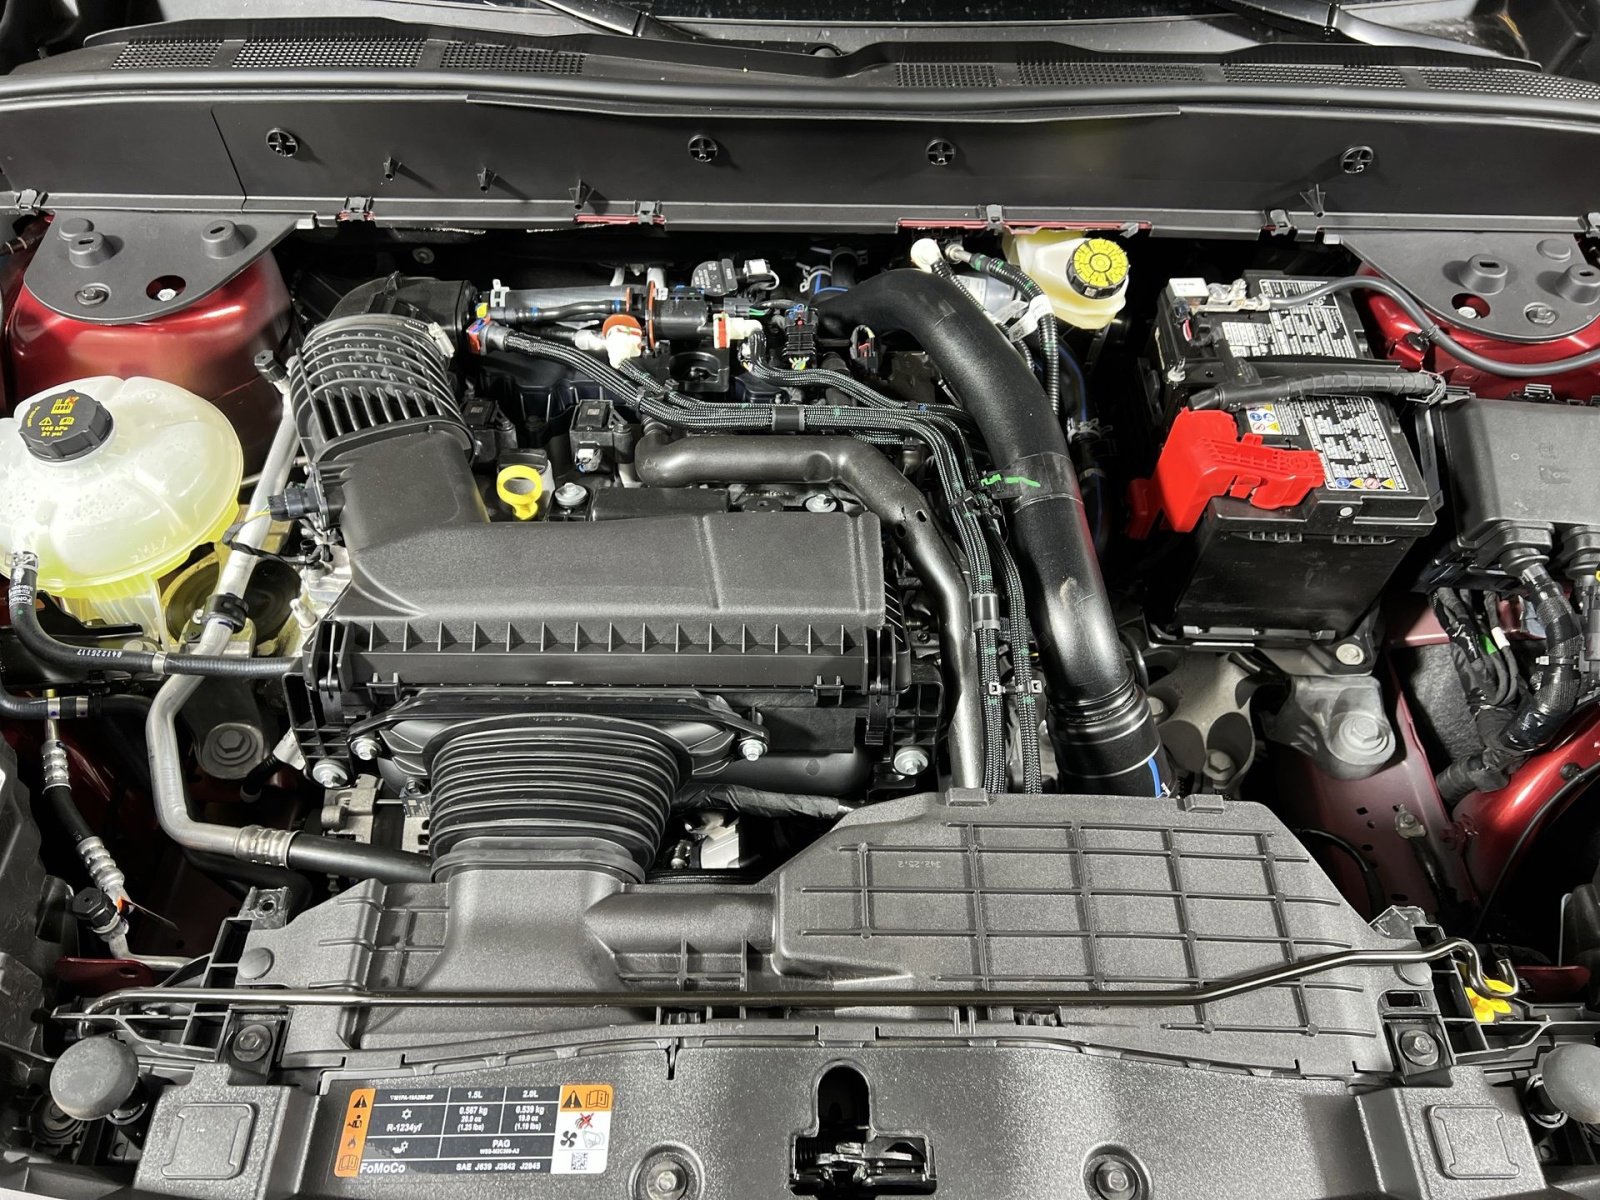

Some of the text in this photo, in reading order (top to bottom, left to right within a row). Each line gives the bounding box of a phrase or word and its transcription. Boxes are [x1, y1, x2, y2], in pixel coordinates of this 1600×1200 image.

[467, 1090, 483, 1098] 1.5L
[522, 1090, 539, 1098] 2.0L
[478, 1106, 488, 1116] kg
[515, 1105, 544, 1116] 0.539 kg
[386, 1123, 422, 1133] R-1234yf
[492, 1139, 511, 1148] PAG
[360, 1162, 406, 1175] FoMoCo
[456, 1163, 472, 1171] SAE
[474, 1162, 492, 1171] J639
